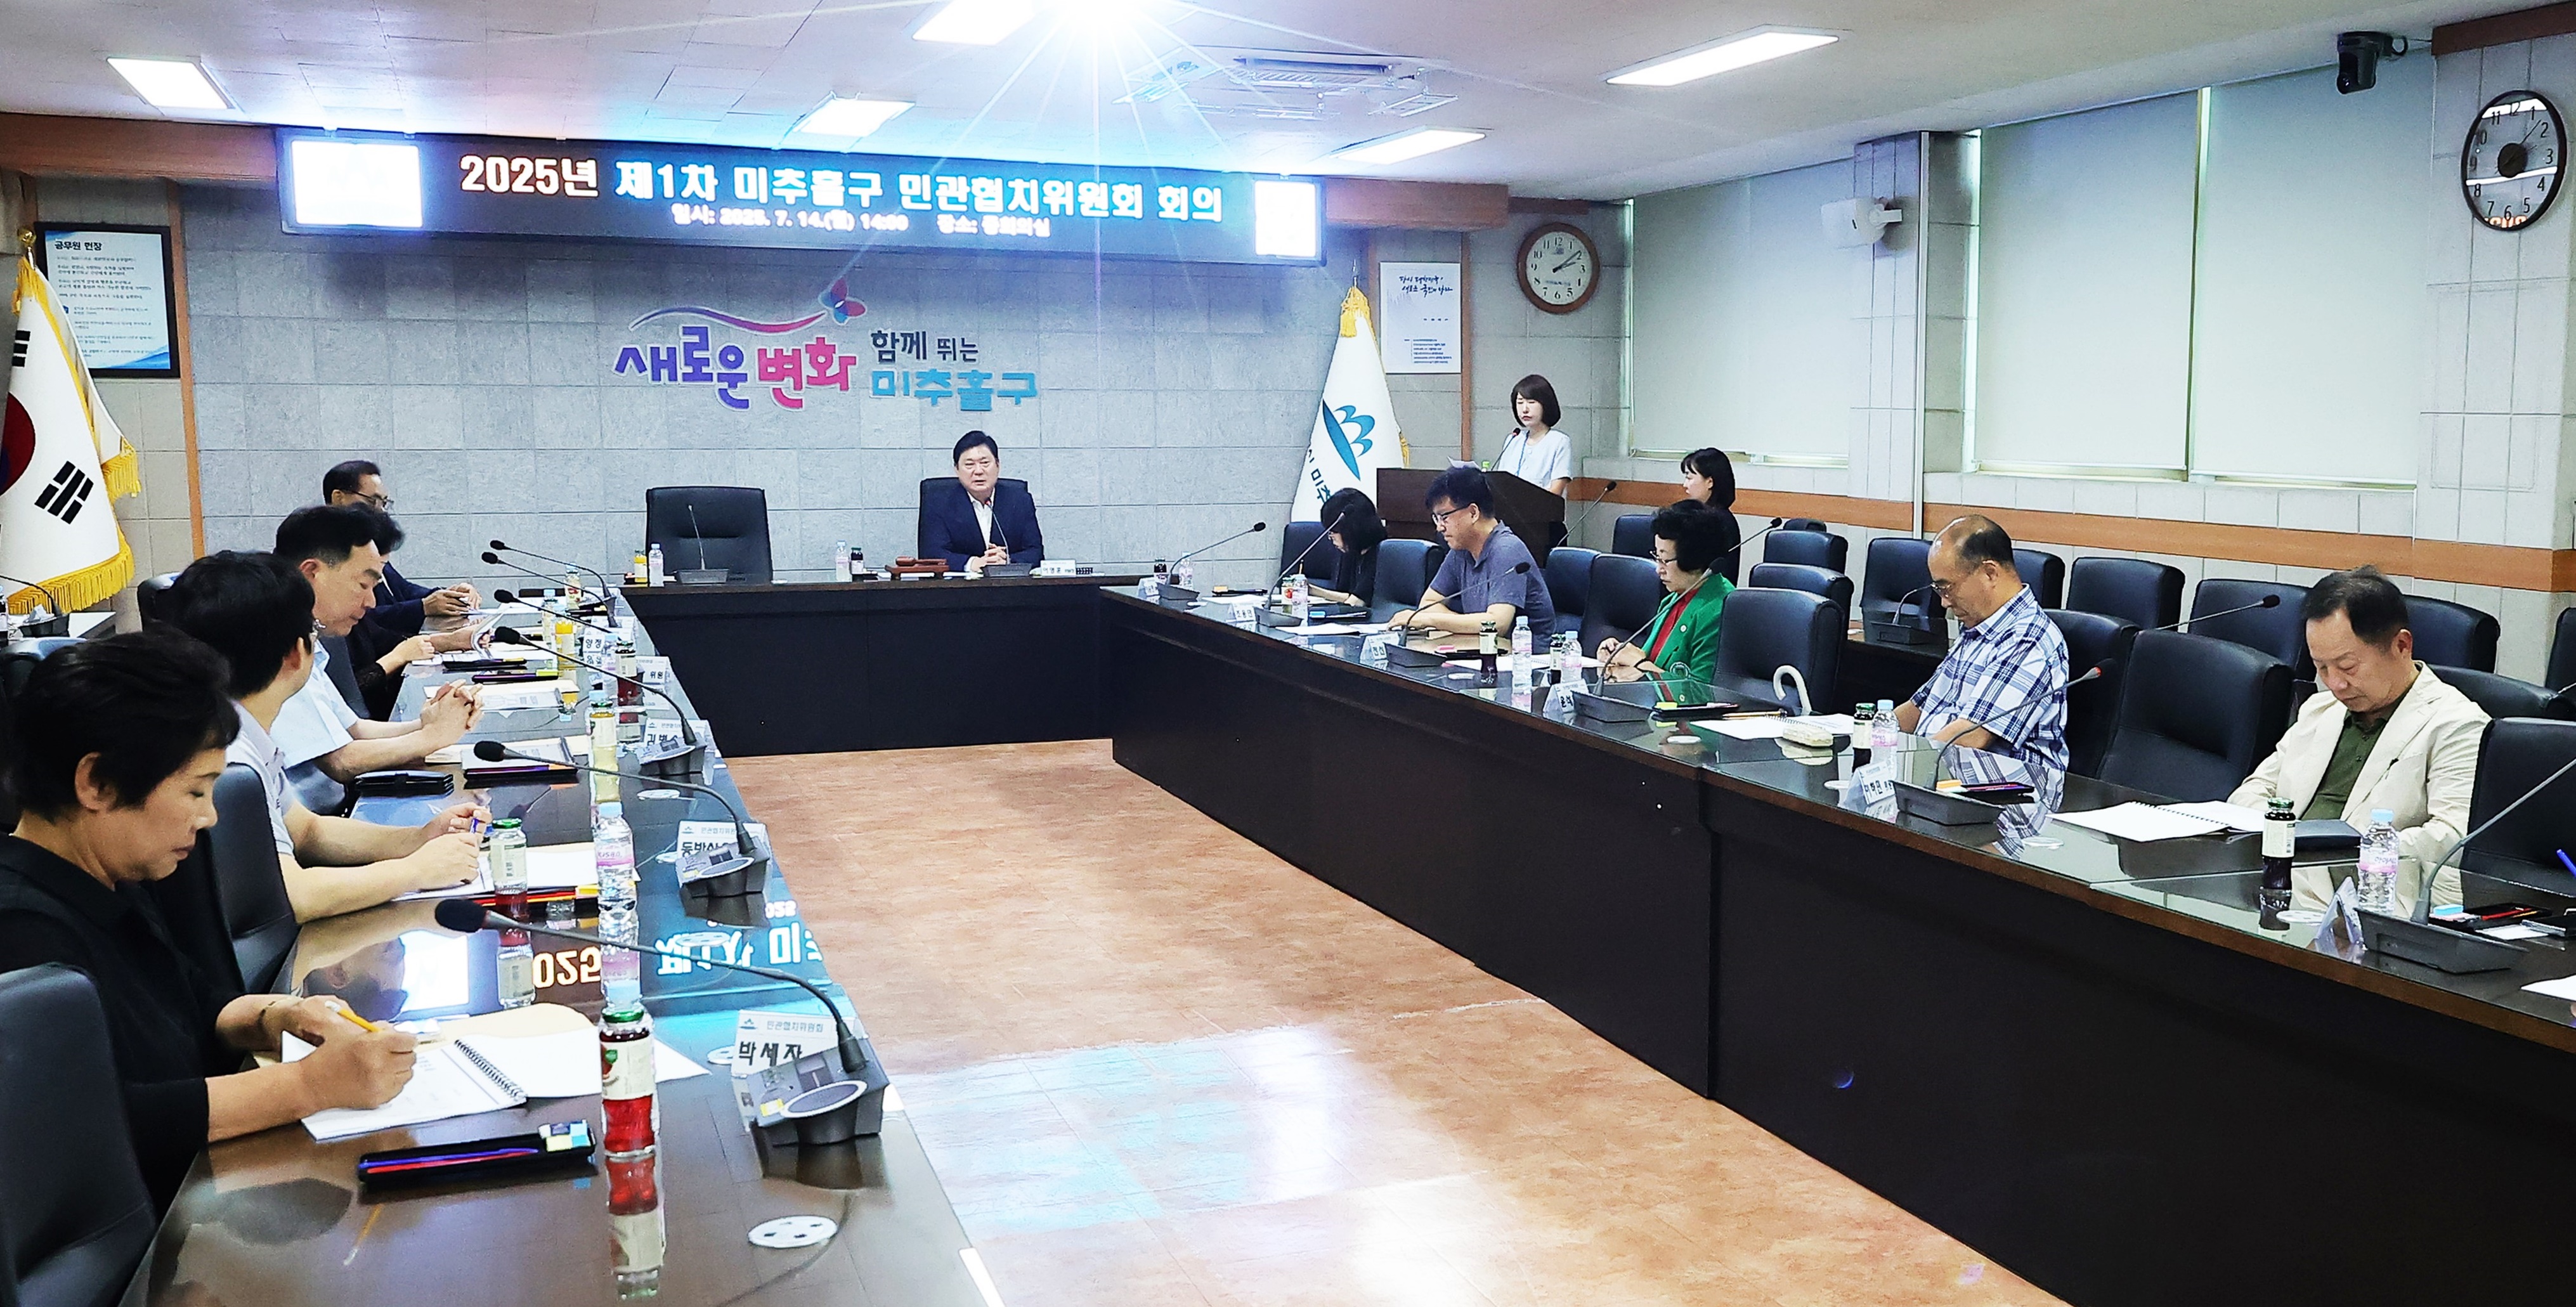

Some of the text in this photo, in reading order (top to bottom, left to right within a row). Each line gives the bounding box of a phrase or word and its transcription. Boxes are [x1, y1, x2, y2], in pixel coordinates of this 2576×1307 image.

[2491, 111, 2501, 125] 11
[2530, 106, 2535, 120] 1
[2540, 122, 2549, 138] 2
[2545, 148, 2553, 164] 3
[460, 153, 1223, 223] 2025년 제1차 미추홀구 민관협치위원회 회의
[2474, 183, 2481, 197] 8
[2537, 176, 2545, 192] 4
[2487, 201, 2494, 216] 7
[2504, 205, 2511, 220] 6
[2523, 198, 2530, 213] 5
[55, 240, 103, 251] 공무원 헌장
[1543, 240, 1550, 249] 11
[1554, 237, 1563, 246] 12
[1570, 241, 1573, 249] 1
[1533, 250, 1542, 259] 10
[1577, 251, 1582, 260] 2
[1580, 264, 1585, 273] 3
[1543, 287, 1548, 296] 7
[1566, 287, 1573, 297] 5
[871, 330, 979, 363] 함께 뛰는
[613, 325, 857, 410] 새로운 변화
[871, 368, 1037, 412] 미추홀구
